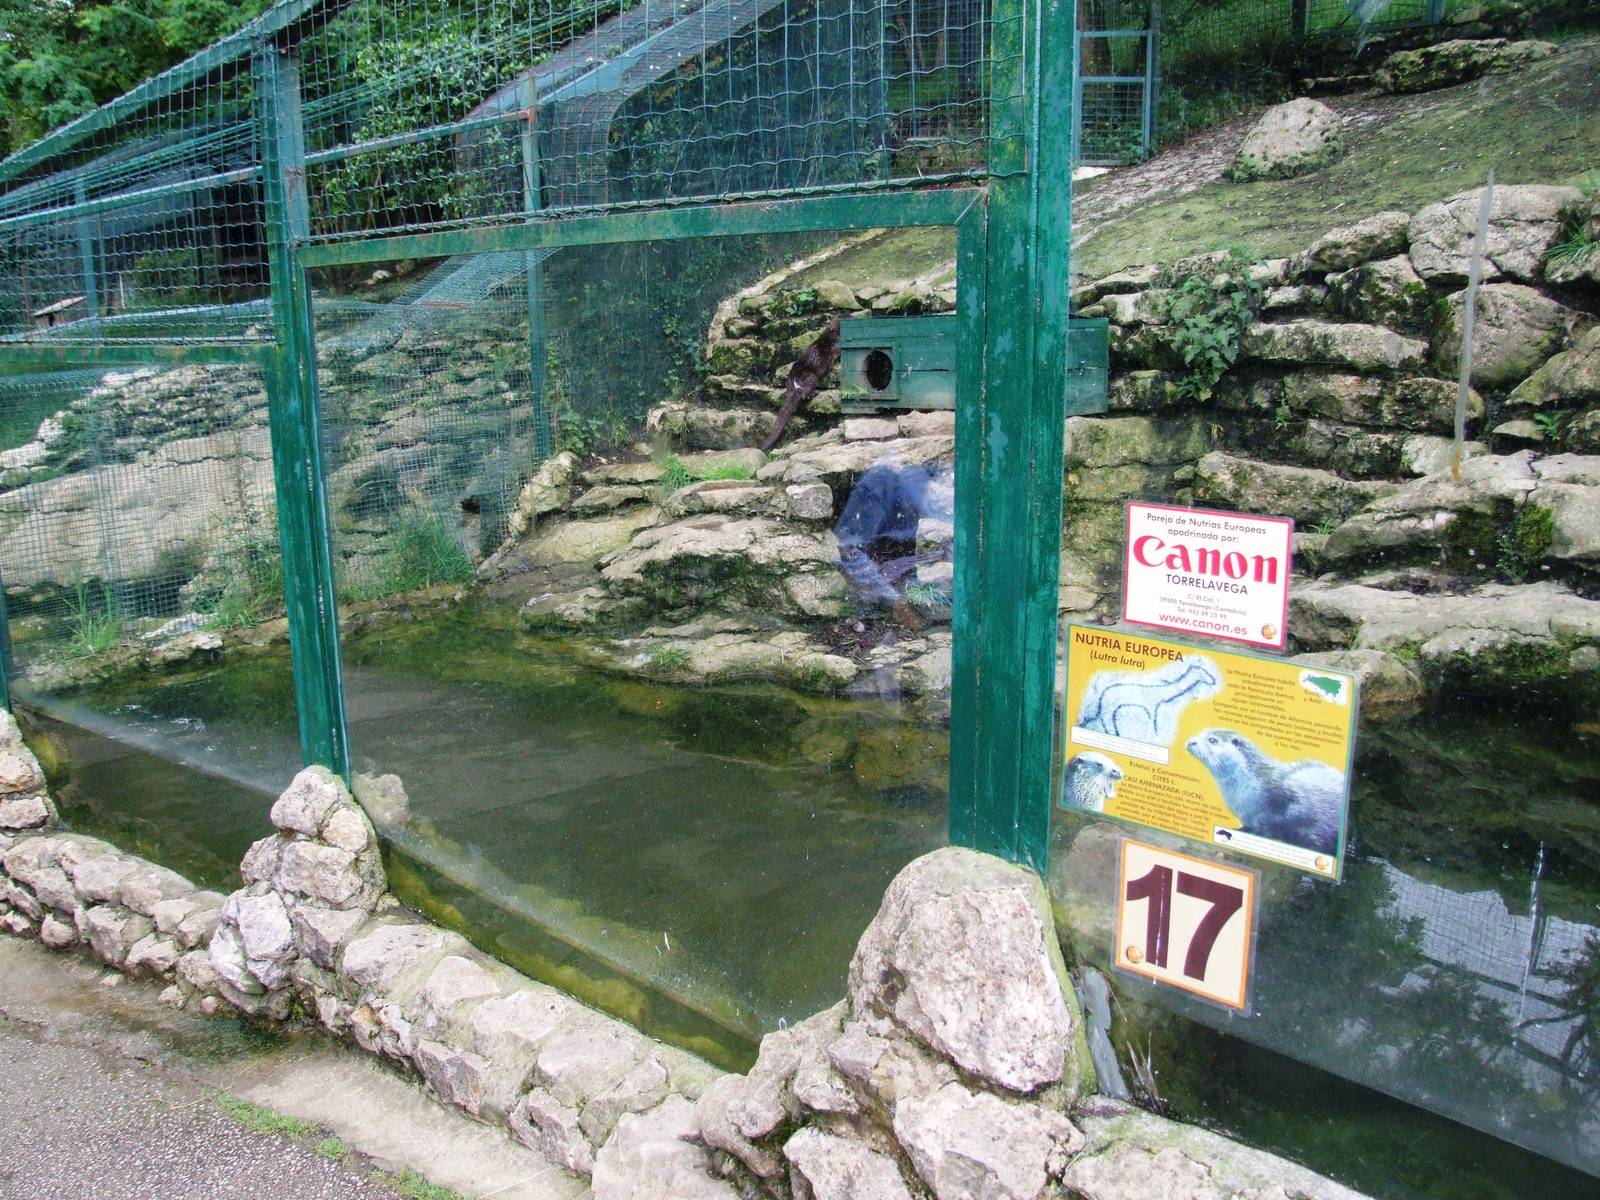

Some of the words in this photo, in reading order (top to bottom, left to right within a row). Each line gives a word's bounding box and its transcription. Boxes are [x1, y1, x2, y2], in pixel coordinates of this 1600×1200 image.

[1146, 512, 1172, 524] Pareja
[1175, 516, 1186, 524] de
[1188, 518, 1221, 529] Nutrias
[1223, 522, 1266, 536] Europeas
[1167, 526, 1218, 541] apadrinada
[1220, 534, 1238, 543] por:
[1133, 536, 1278, 584] Canon
[1165, 573, 1248, 595] TORRELAVEGA
[1158, 613, 1246, 635] www.canon.es
[1076, 632, 1122, 652] NUTRIA
[1126, 644, 1184, 662] EUROPEA
[1090, 651, 1118, 668] (Lutra
[1120, 655, 1146, 670] lutra)
[1152, 774, 1169, 783] CITES
[1126, 864, 1244, 982] 17
